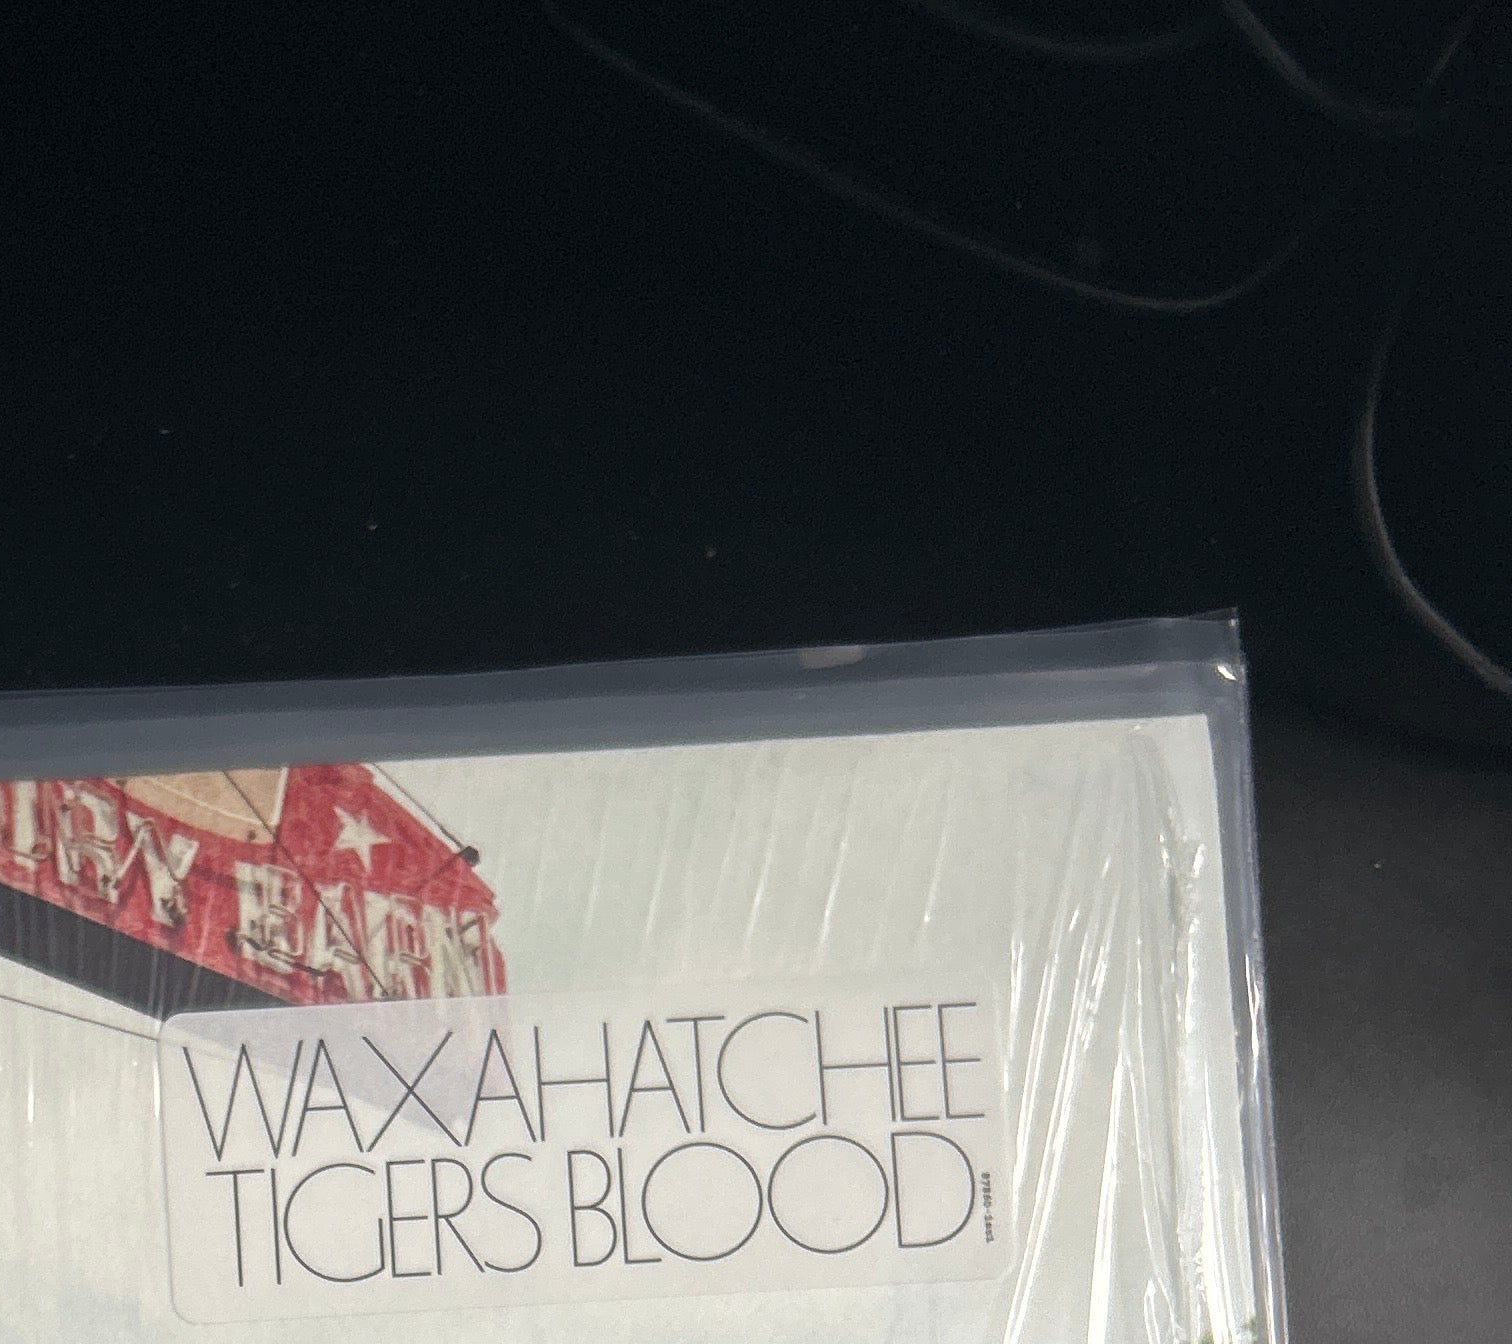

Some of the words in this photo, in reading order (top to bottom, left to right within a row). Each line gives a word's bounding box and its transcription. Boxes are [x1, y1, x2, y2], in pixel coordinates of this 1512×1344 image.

[183, 1001, 986, 1162] WAXAHATCHEE
[205, 1152, 543, 1288] TIGERS
[567, 1131, 976, 1268] BLOOD
